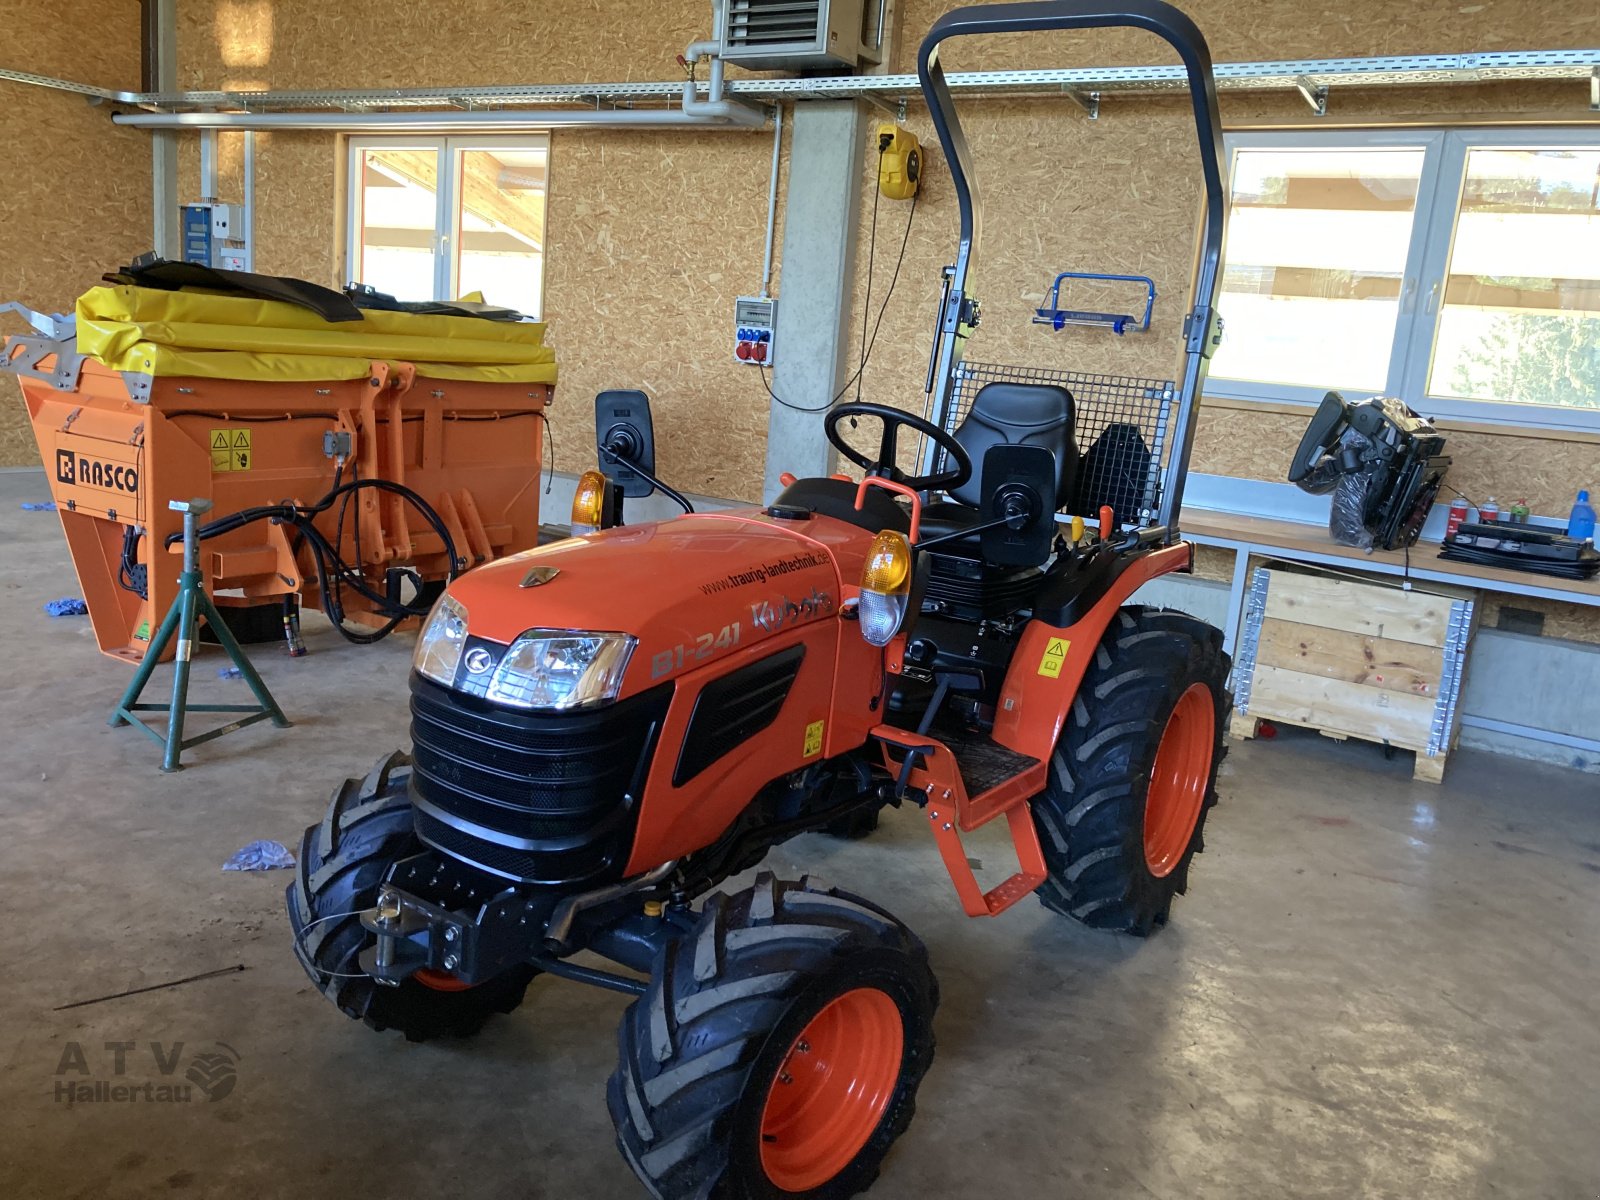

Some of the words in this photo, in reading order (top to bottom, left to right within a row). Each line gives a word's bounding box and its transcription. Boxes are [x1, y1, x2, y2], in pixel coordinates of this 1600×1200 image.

[80, 459, 138, 492] RASCO
[698, 551, 830, 595] www.traurig-landtechnik.de
[652, 622, 740, 679] B1-241
